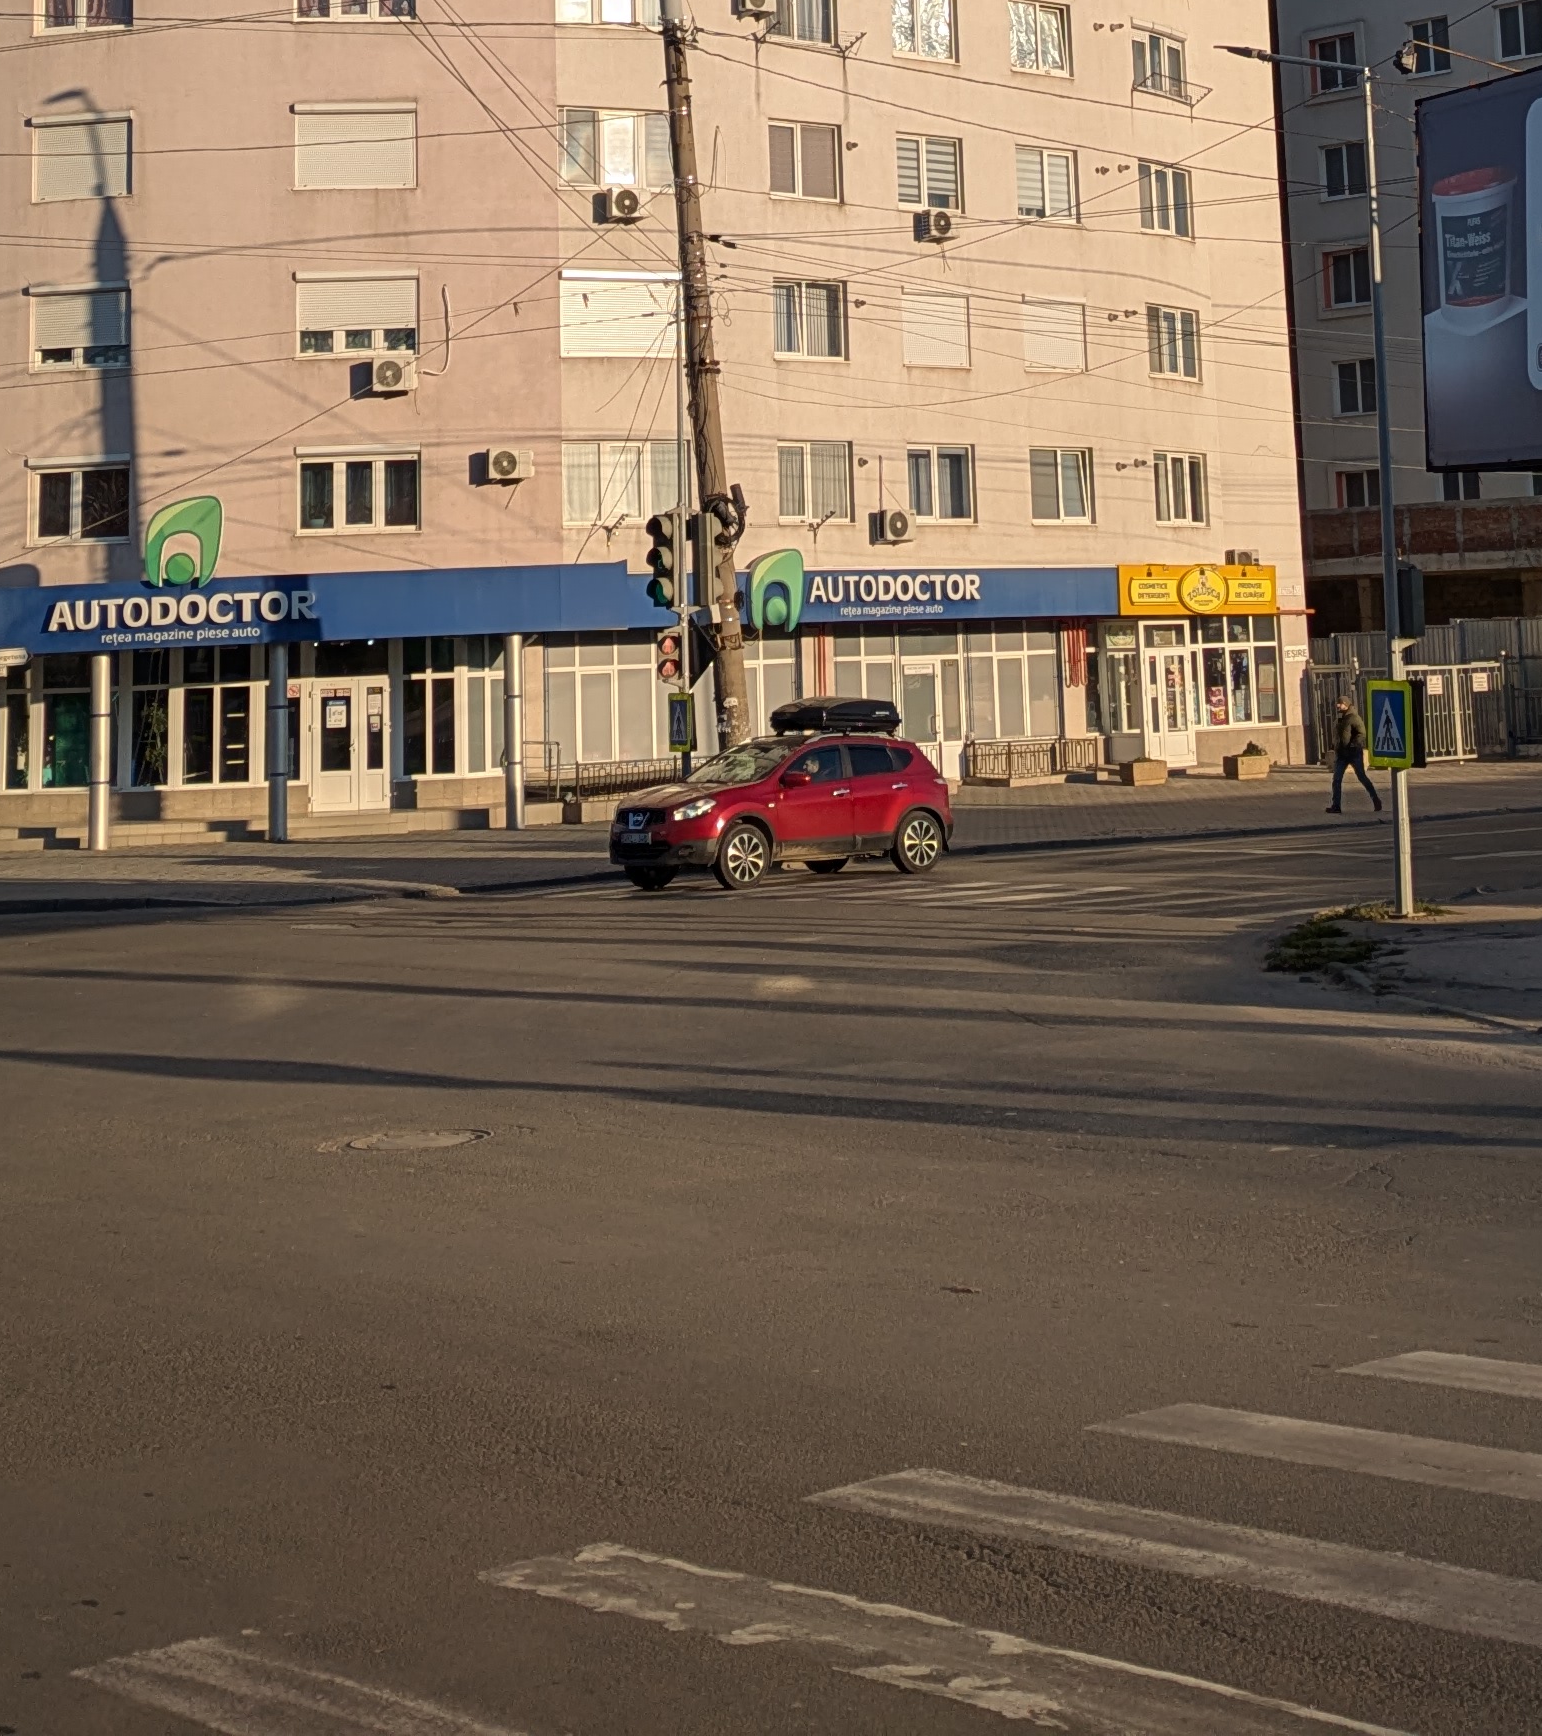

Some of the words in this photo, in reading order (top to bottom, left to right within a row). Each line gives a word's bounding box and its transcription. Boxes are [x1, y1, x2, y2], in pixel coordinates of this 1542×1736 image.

[809, 574, 981, 603] AUTODOCTOR
[47, 590, 317, 632] AUTODOCTOR
[925, 604, 944, 614] auto
[134, 629, 194, 643] magazine
[196, 627, 230, 642] piese
[231, 626, 261, 637] auto
